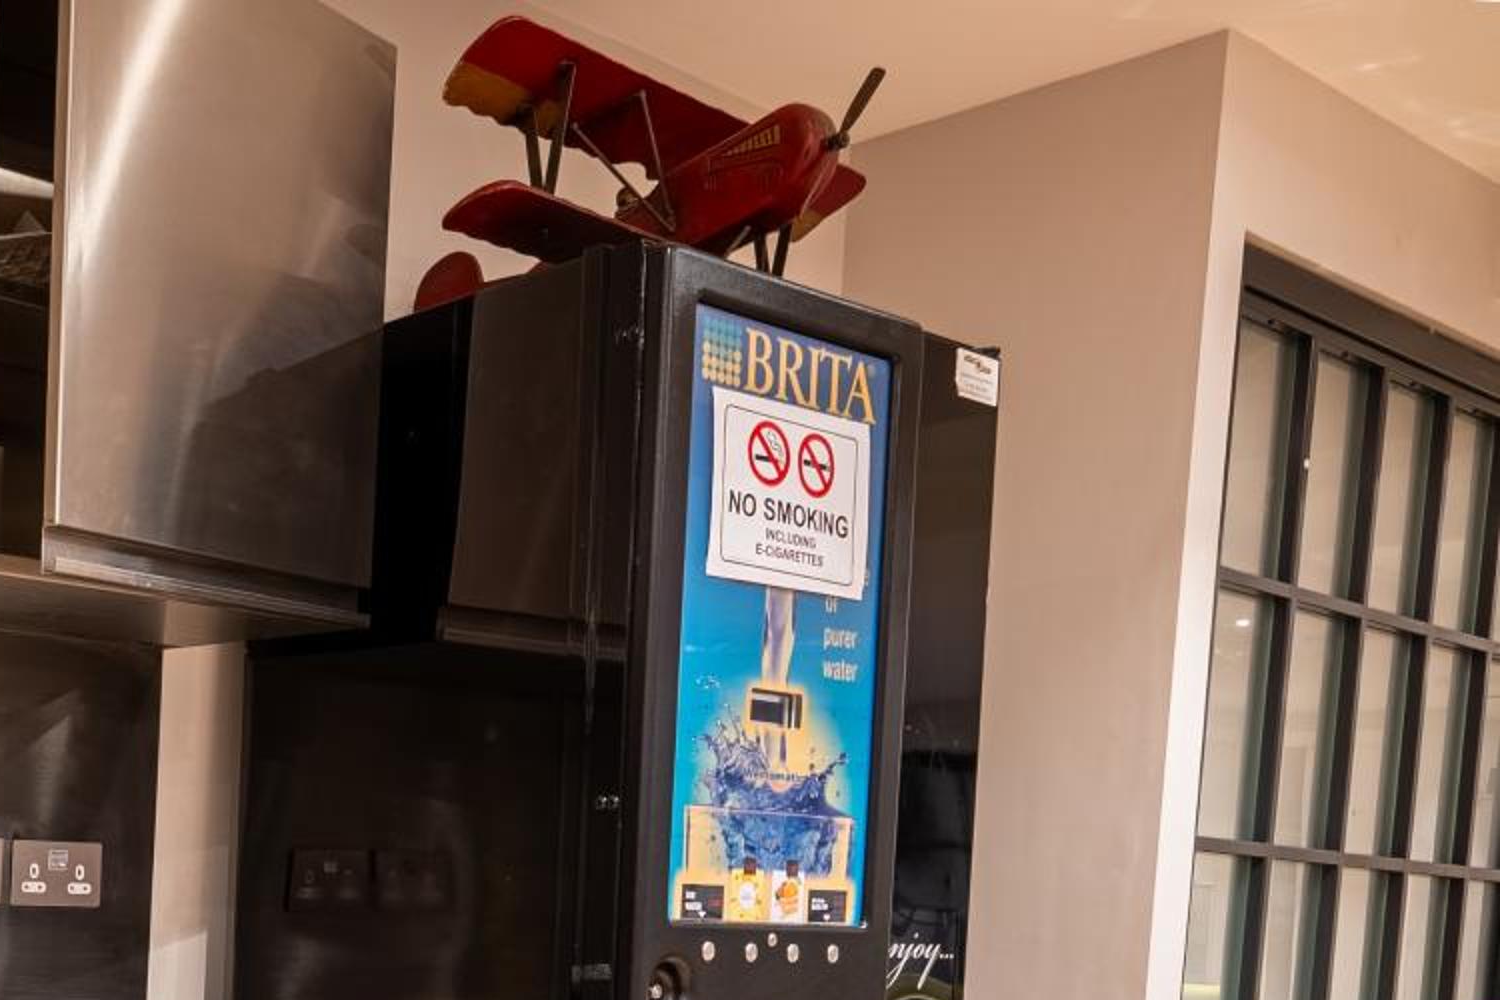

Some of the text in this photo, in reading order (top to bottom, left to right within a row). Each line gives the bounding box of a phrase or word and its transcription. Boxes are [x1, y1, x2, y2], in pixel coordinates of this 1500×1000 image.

[744, 327, 875, 423] BRITA
[729, 489, 849, 539] NO SMOKING
[765, 528, 816, 548] INCLUDING
[755, 543, 823, 567] E-CIGARETTES
[823, 628, 858, 650] purer
[823, 659, 859, 684] water
